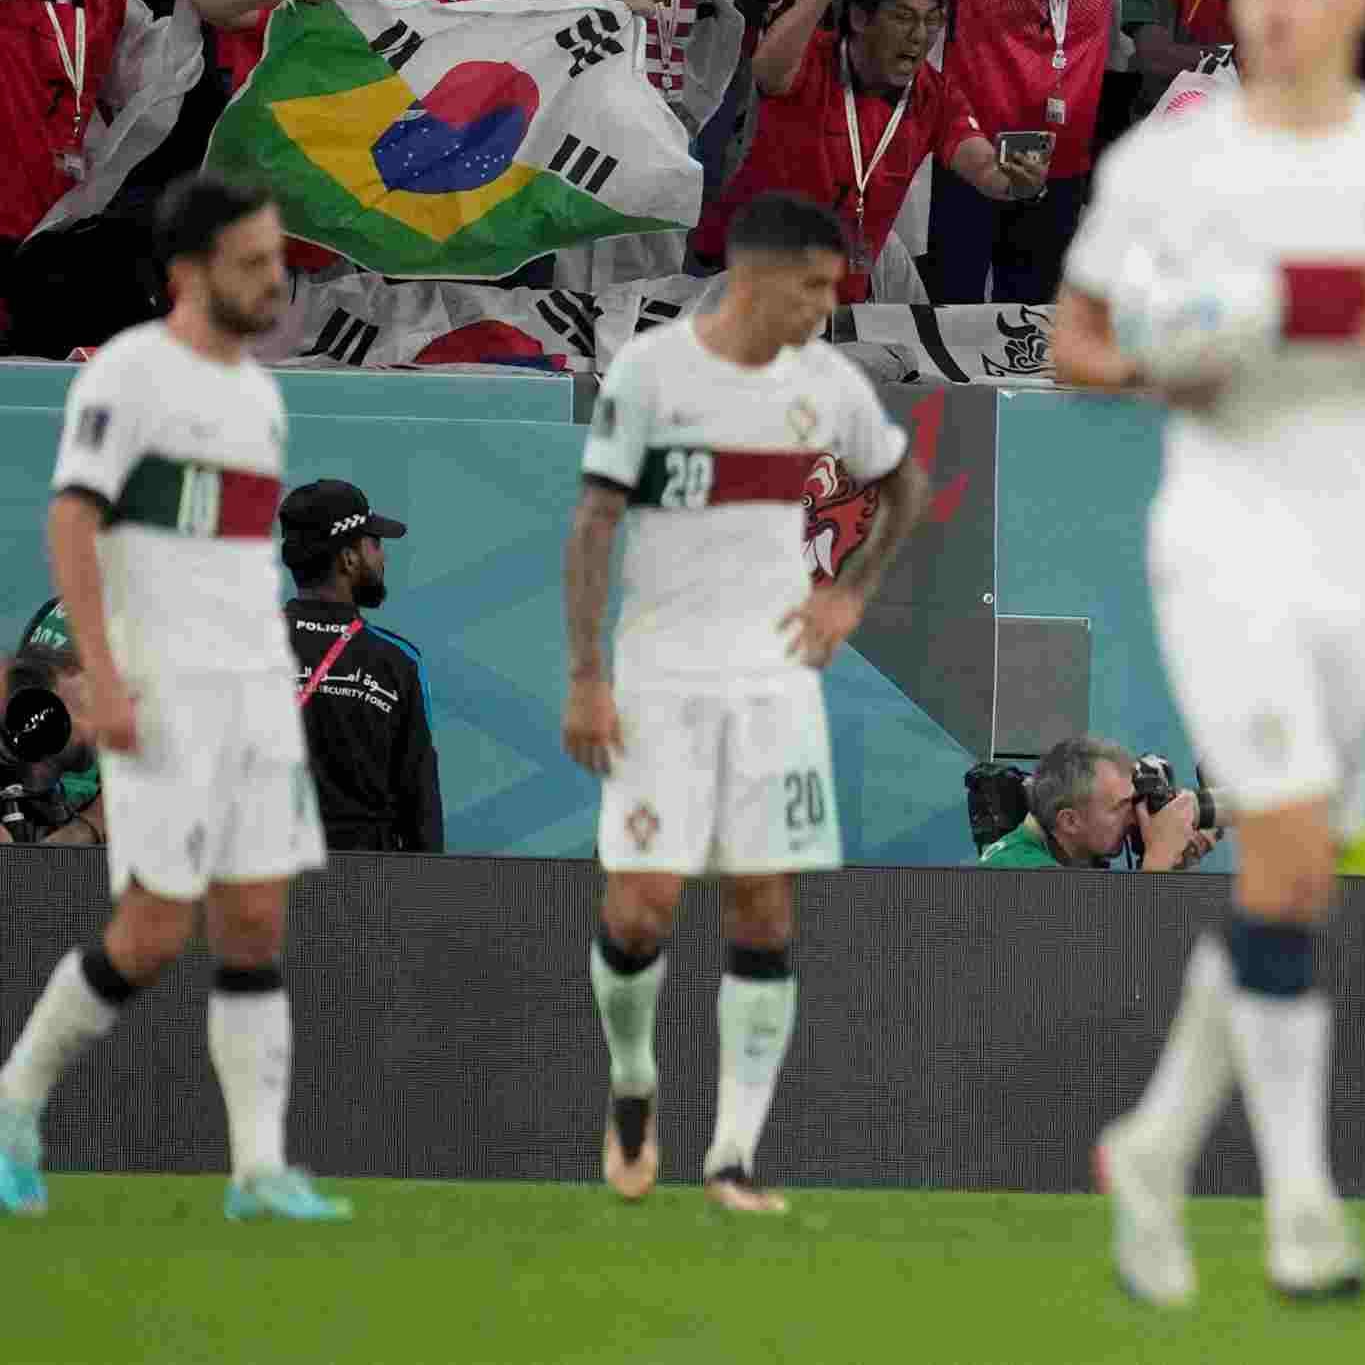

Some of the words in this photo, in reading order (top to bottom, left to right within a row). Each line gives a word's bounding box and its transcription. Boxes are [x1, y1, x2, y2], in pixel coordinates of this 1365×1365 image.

[661, 450, 714, 508] 20
[364, 693, 393, 714] FORCE
[783, 771, 825, 831] 20
